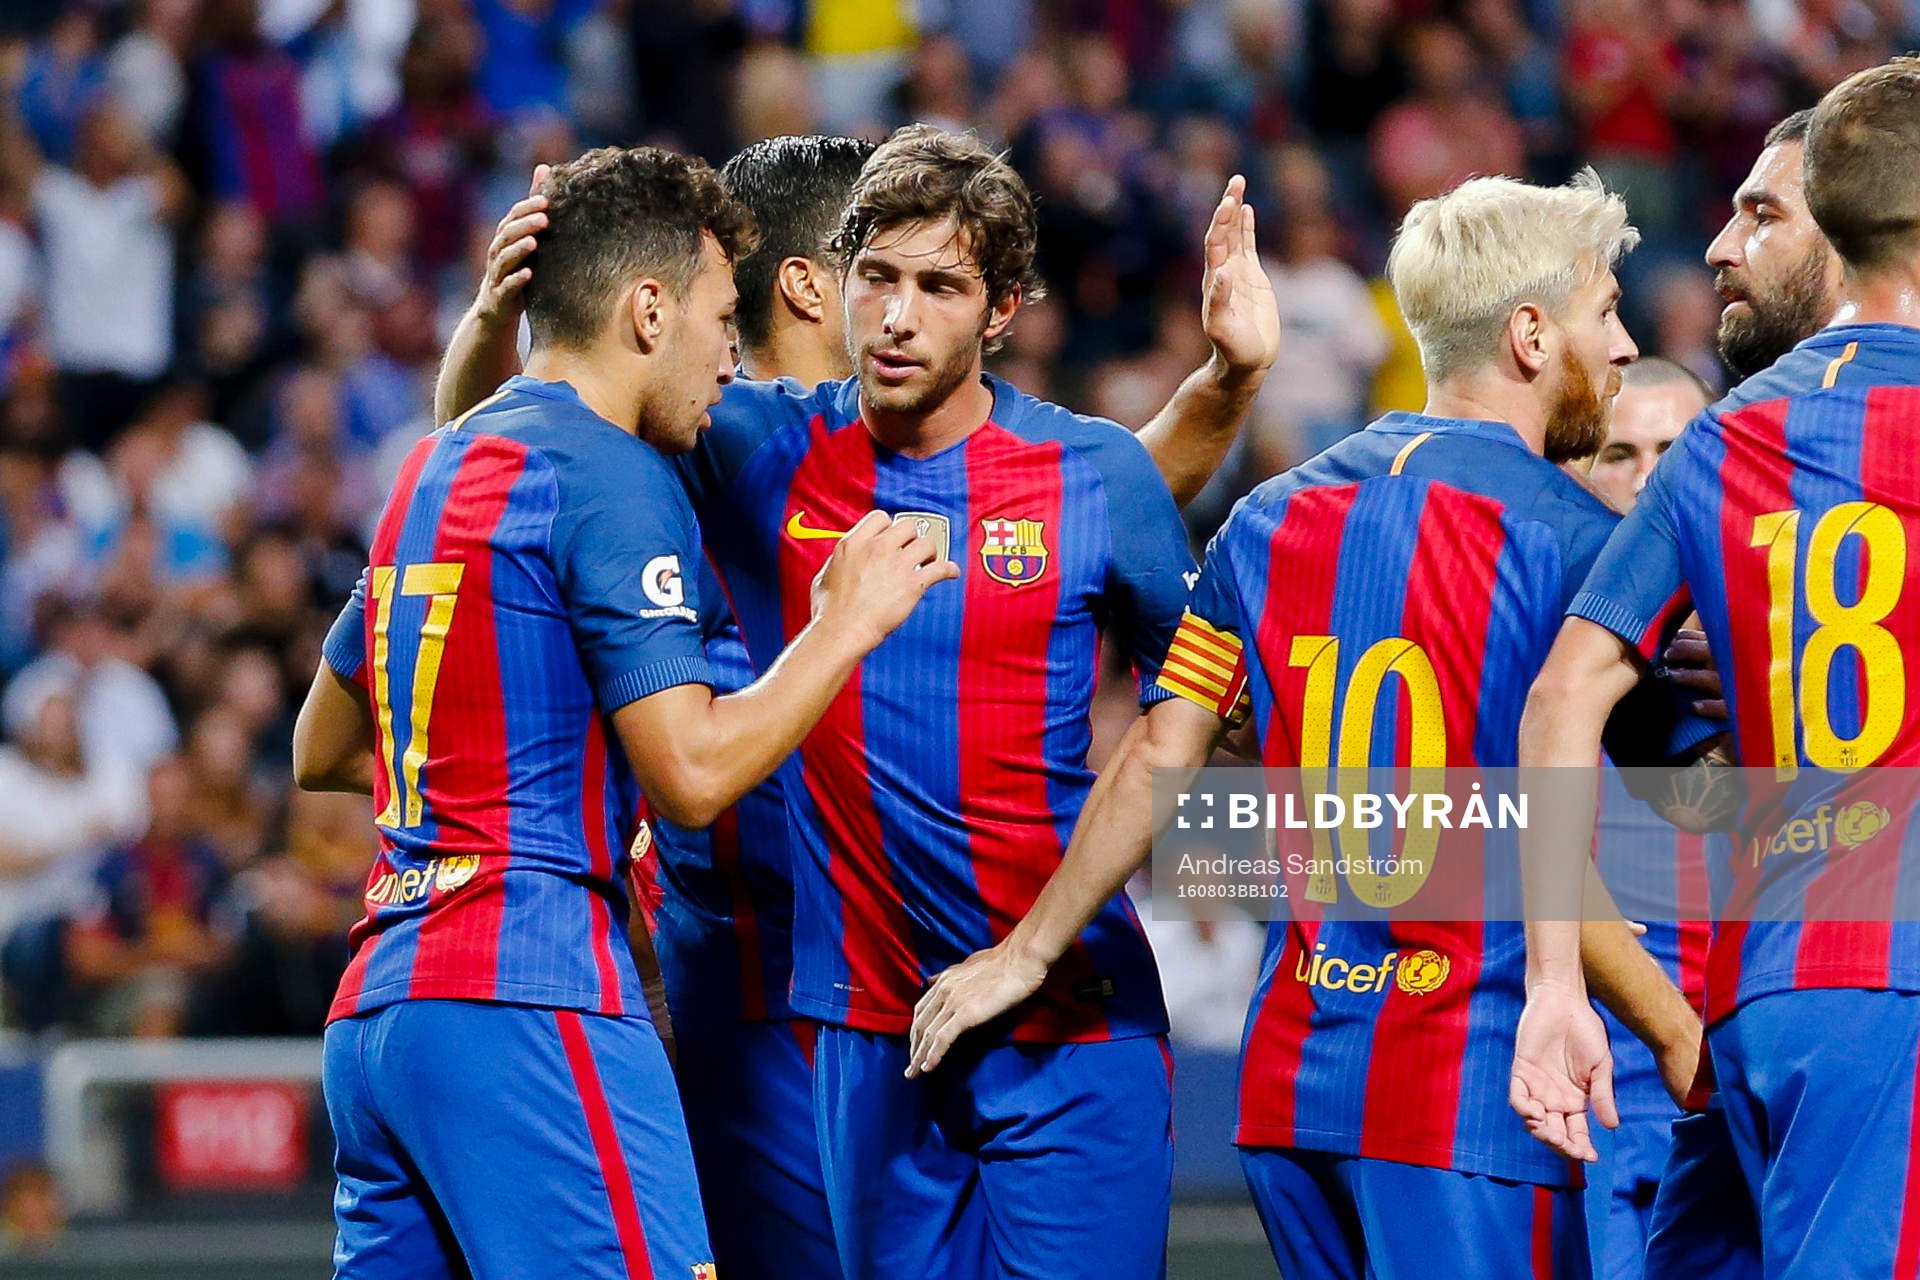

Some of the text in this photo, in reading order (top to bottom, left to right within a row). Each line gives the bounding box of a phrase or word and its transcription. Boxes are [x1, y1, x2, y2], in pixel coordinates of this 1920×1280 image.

[1002, 545, 1027, 556] FCB
[1749, 500, 1907, 783] 18
[372, 562, 466, 829] 17
[1287, 635, 1447, 909] 10
[1295, 942, 1398, 993] uicef
